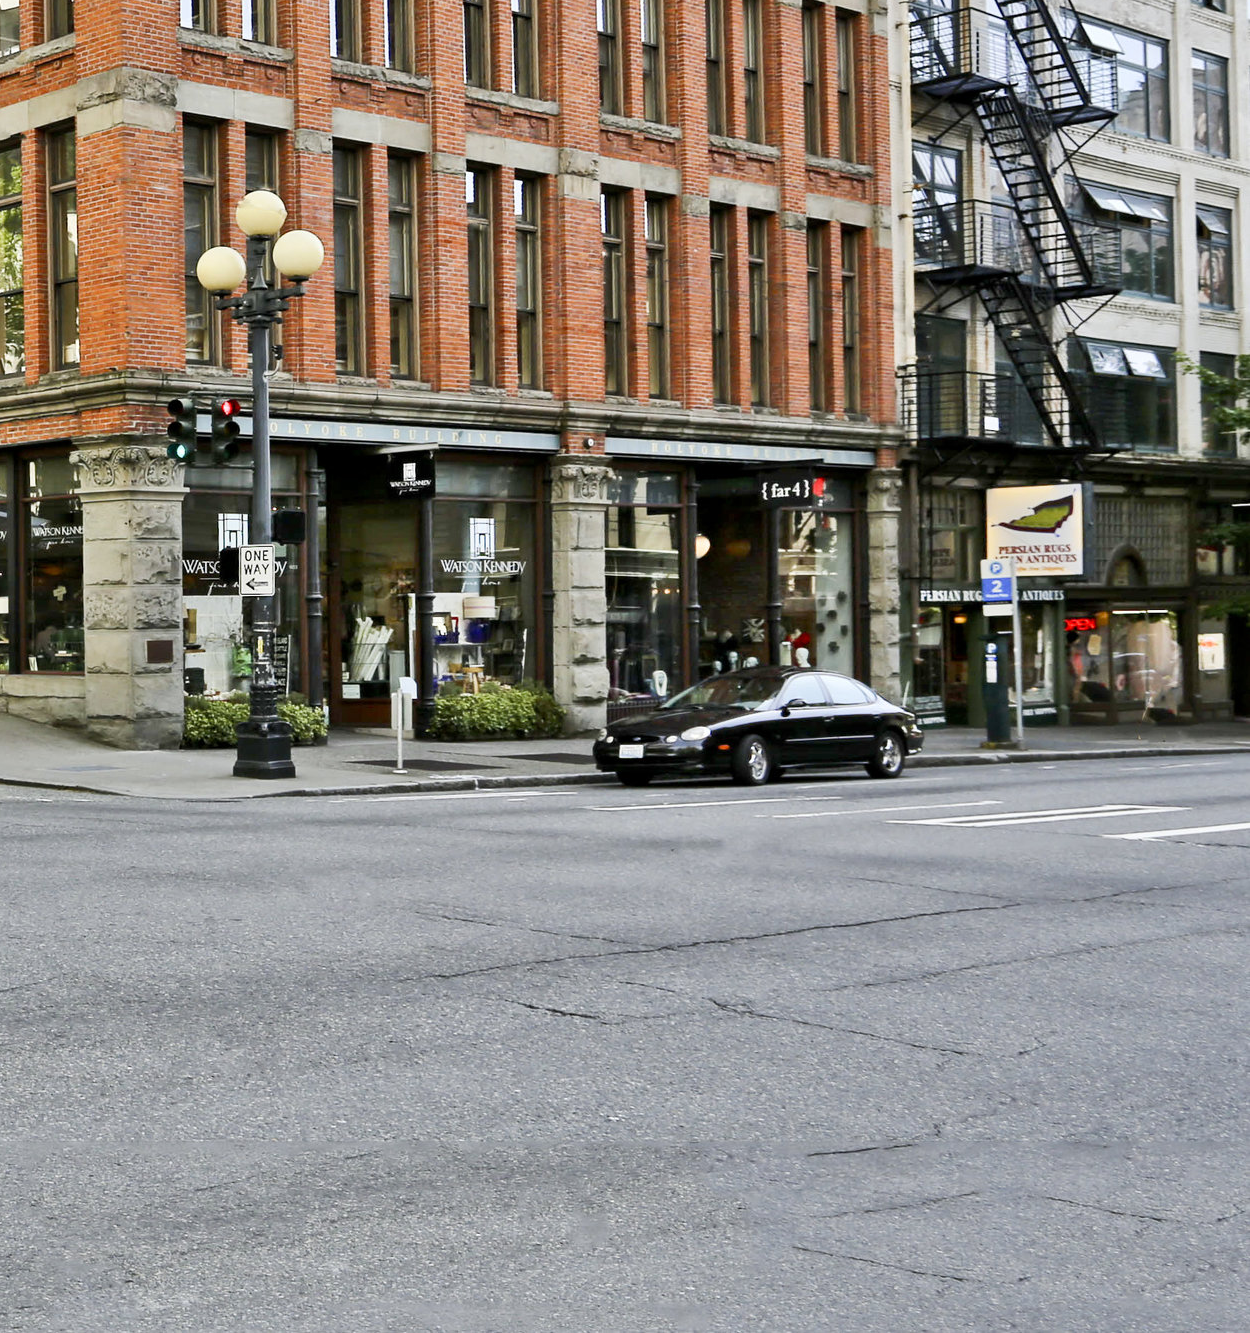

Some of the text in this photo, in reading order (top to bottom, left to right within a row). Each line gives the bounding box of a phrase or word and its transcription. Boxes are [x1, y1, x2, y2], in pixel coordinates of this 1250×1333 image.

[268, 422, 502, 443] OLYOKE BUILDING
[62, 526, 83, 536] KENNE
[998, 544, 1071, 555] PERSIAN RUGS
[244, 550, 269, 561] ONE
[1025, 554, 1077, 564] ANTIQUES
[182, 559, 220, 574] WATSO
[244, 564, 270, 575] WAY
[440, 559, 526, 575] WATSON KENNEDY
[991, 579, 1003, 593] 2
[920, 590, 961, 602] PERSIAN
[962, 590, 983, 601] RUG
[1021, 590, 1064, 601] ANTIQUES
